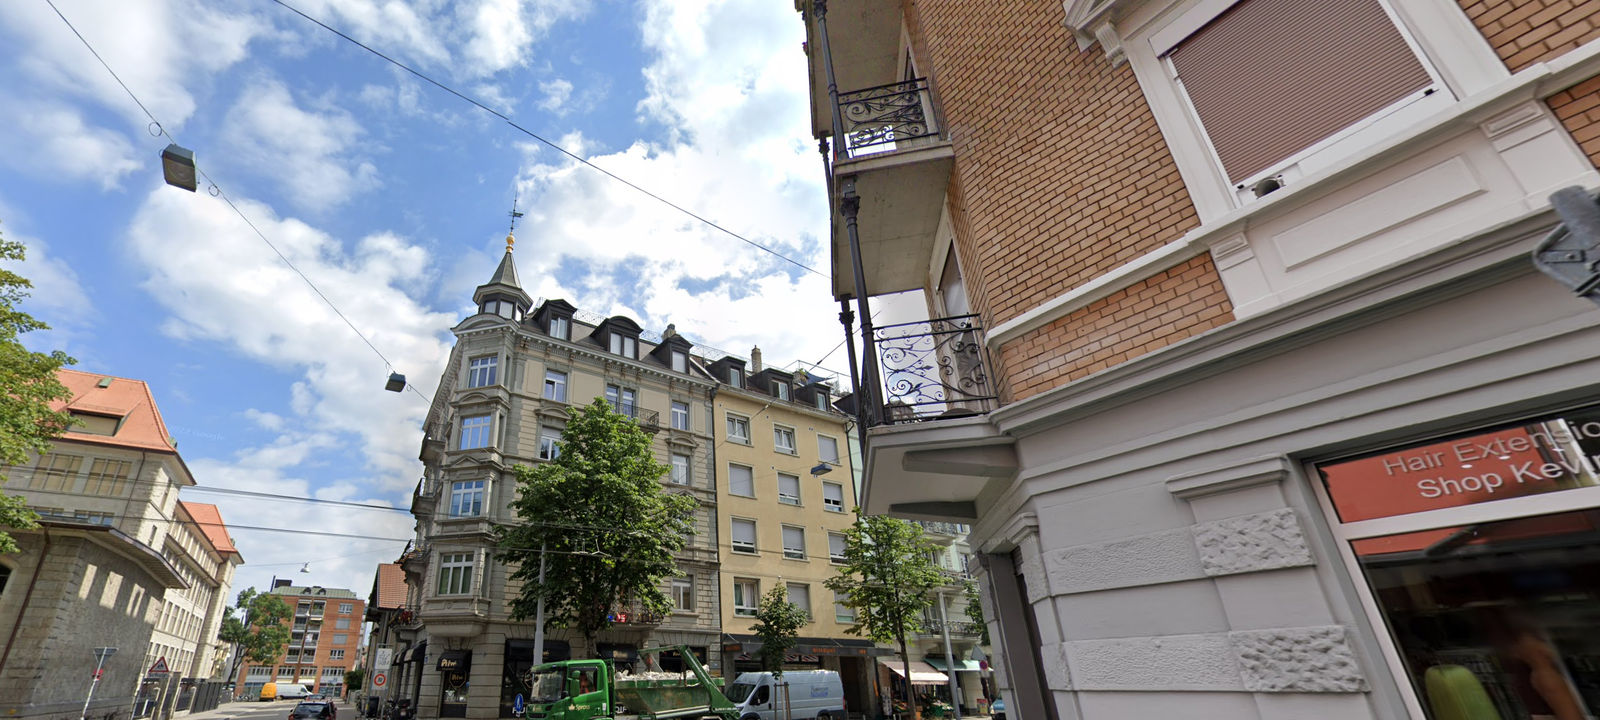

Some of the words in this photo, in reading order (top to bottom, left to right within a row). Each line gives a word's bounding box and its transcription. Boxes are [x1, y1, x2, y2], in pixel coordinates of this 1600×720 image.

[1383, 451, 1444, 475] Hair
[1452, 421, 1600, 462] Extensio
[1417, 473, 1503, 498] Shop
